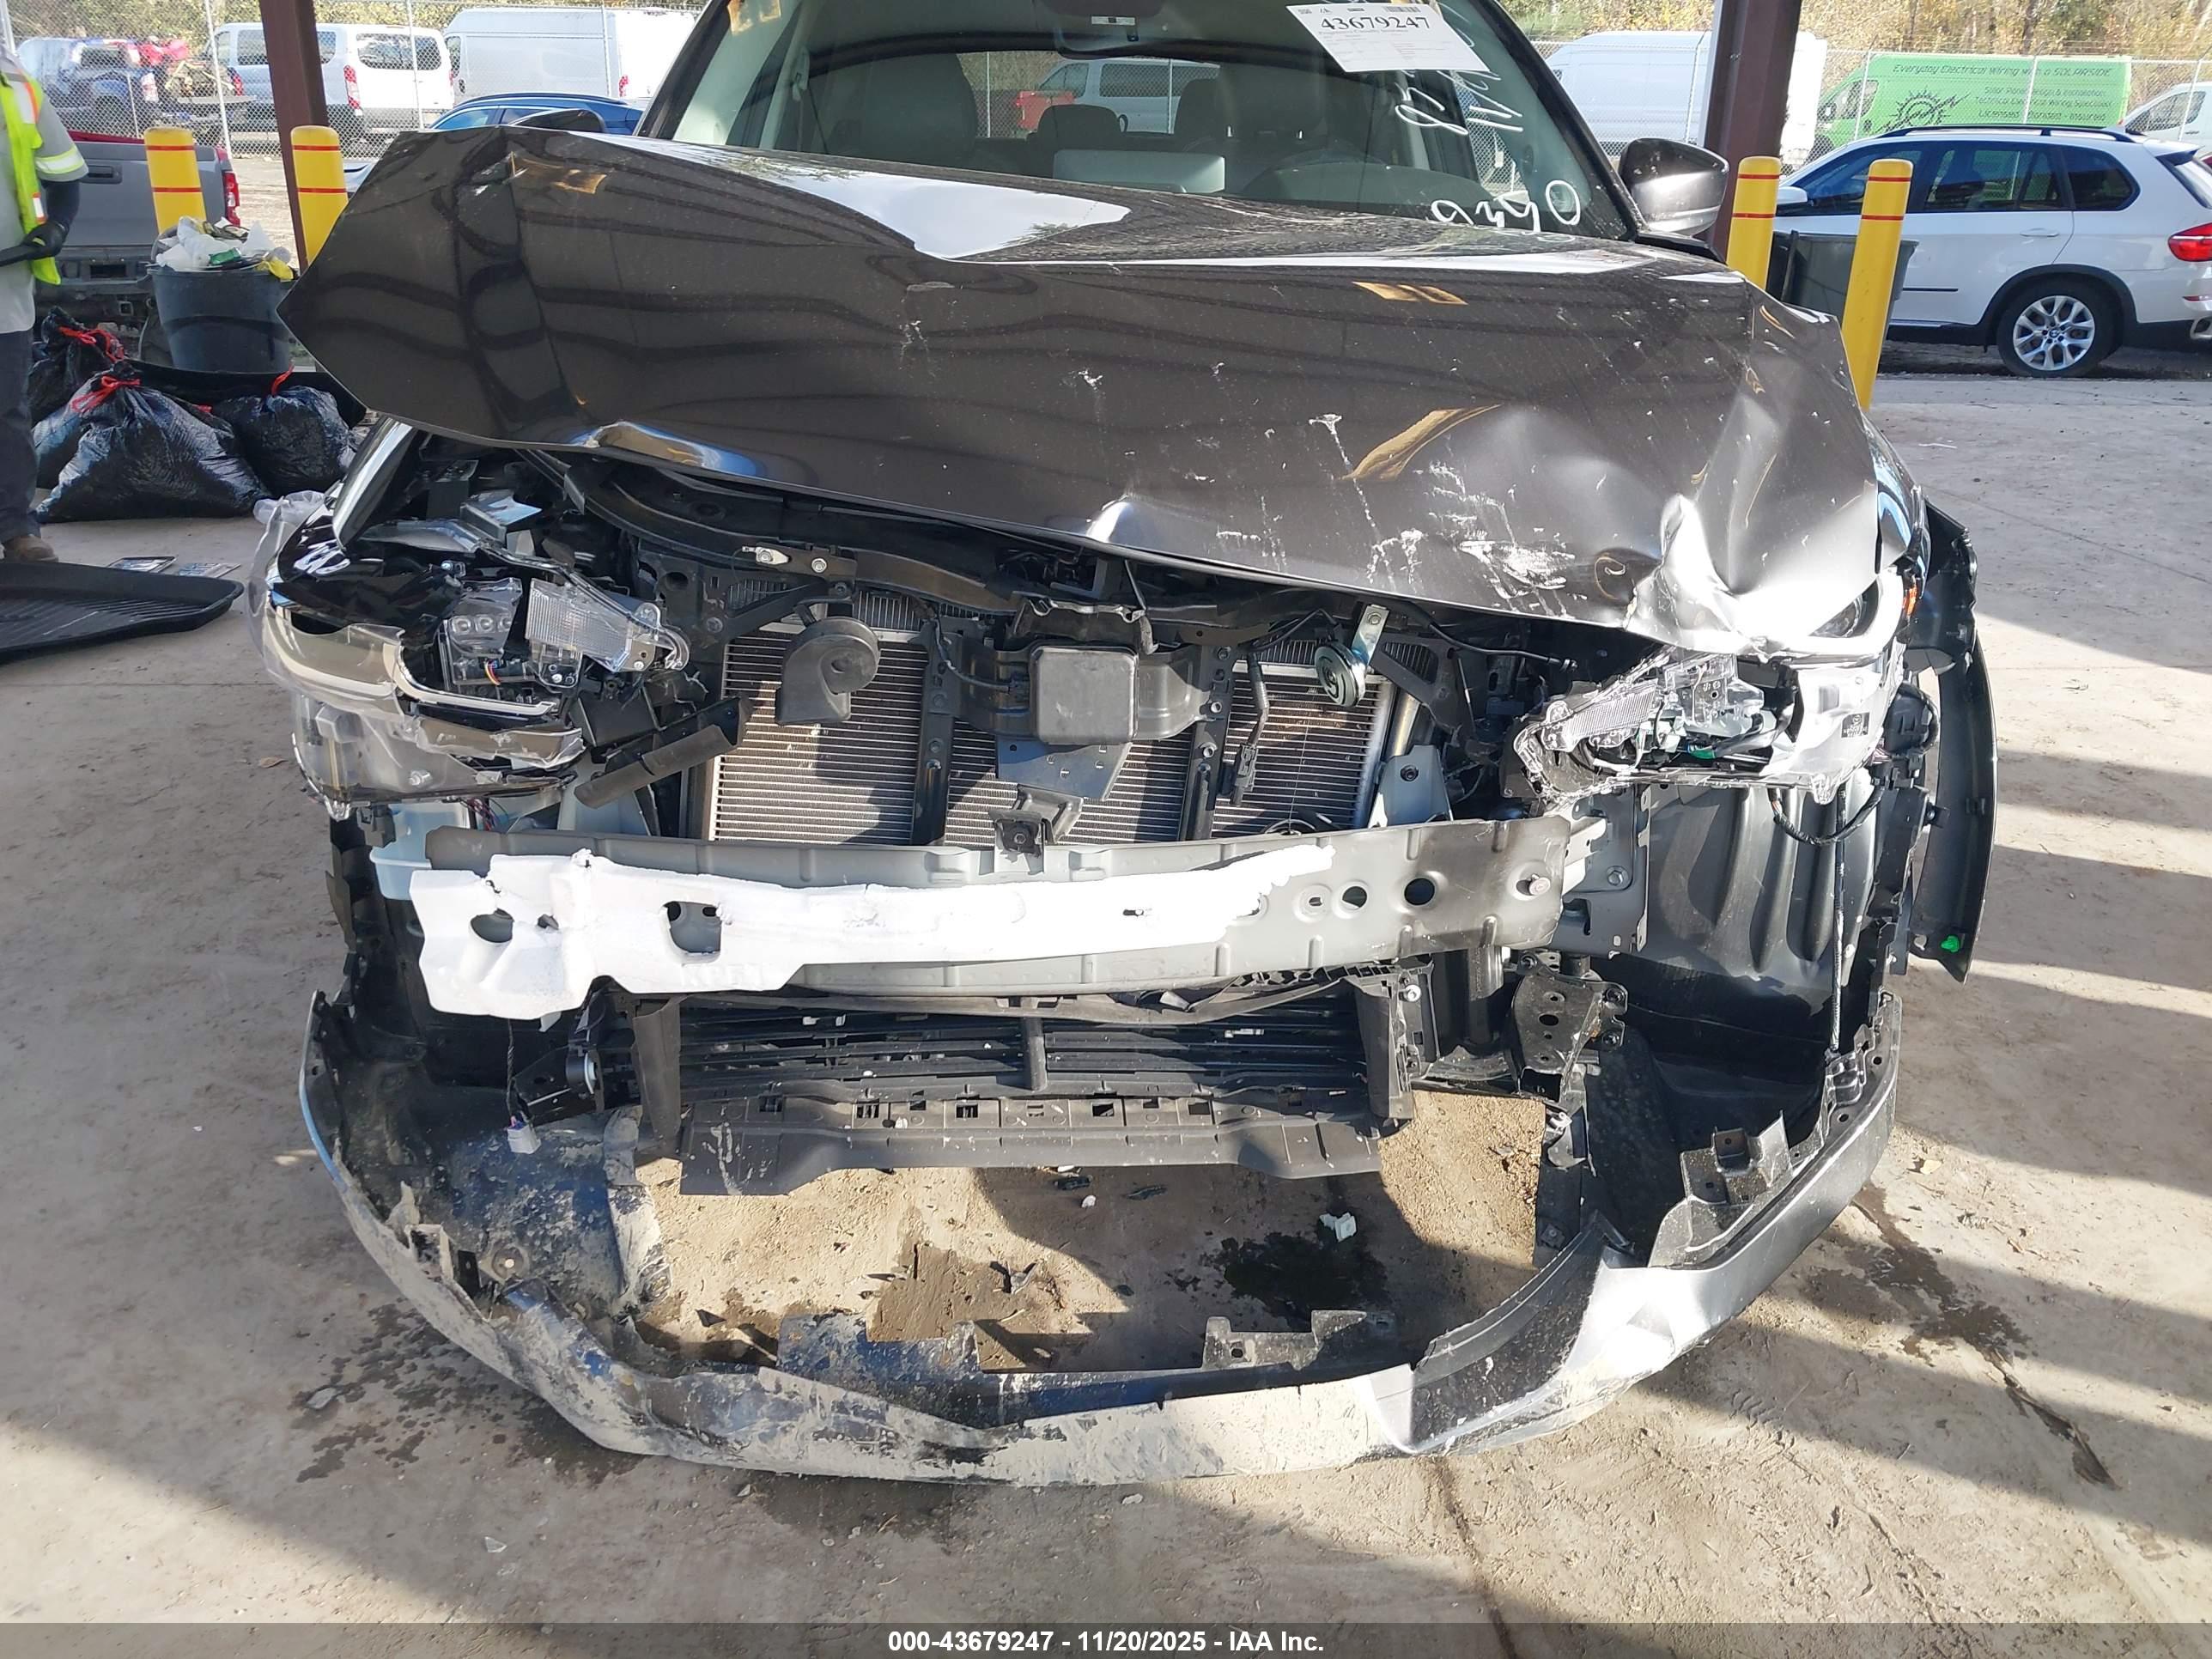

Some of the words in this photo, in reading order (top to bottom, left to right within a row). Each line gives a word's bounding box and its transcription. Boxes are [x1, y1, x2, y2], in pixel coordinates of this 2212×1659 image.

[1321, 16, 1430, 30] 43679247
[1893, 64, 1940, 75] Everyday
[1941, 65, 1987, 76] Electrical
